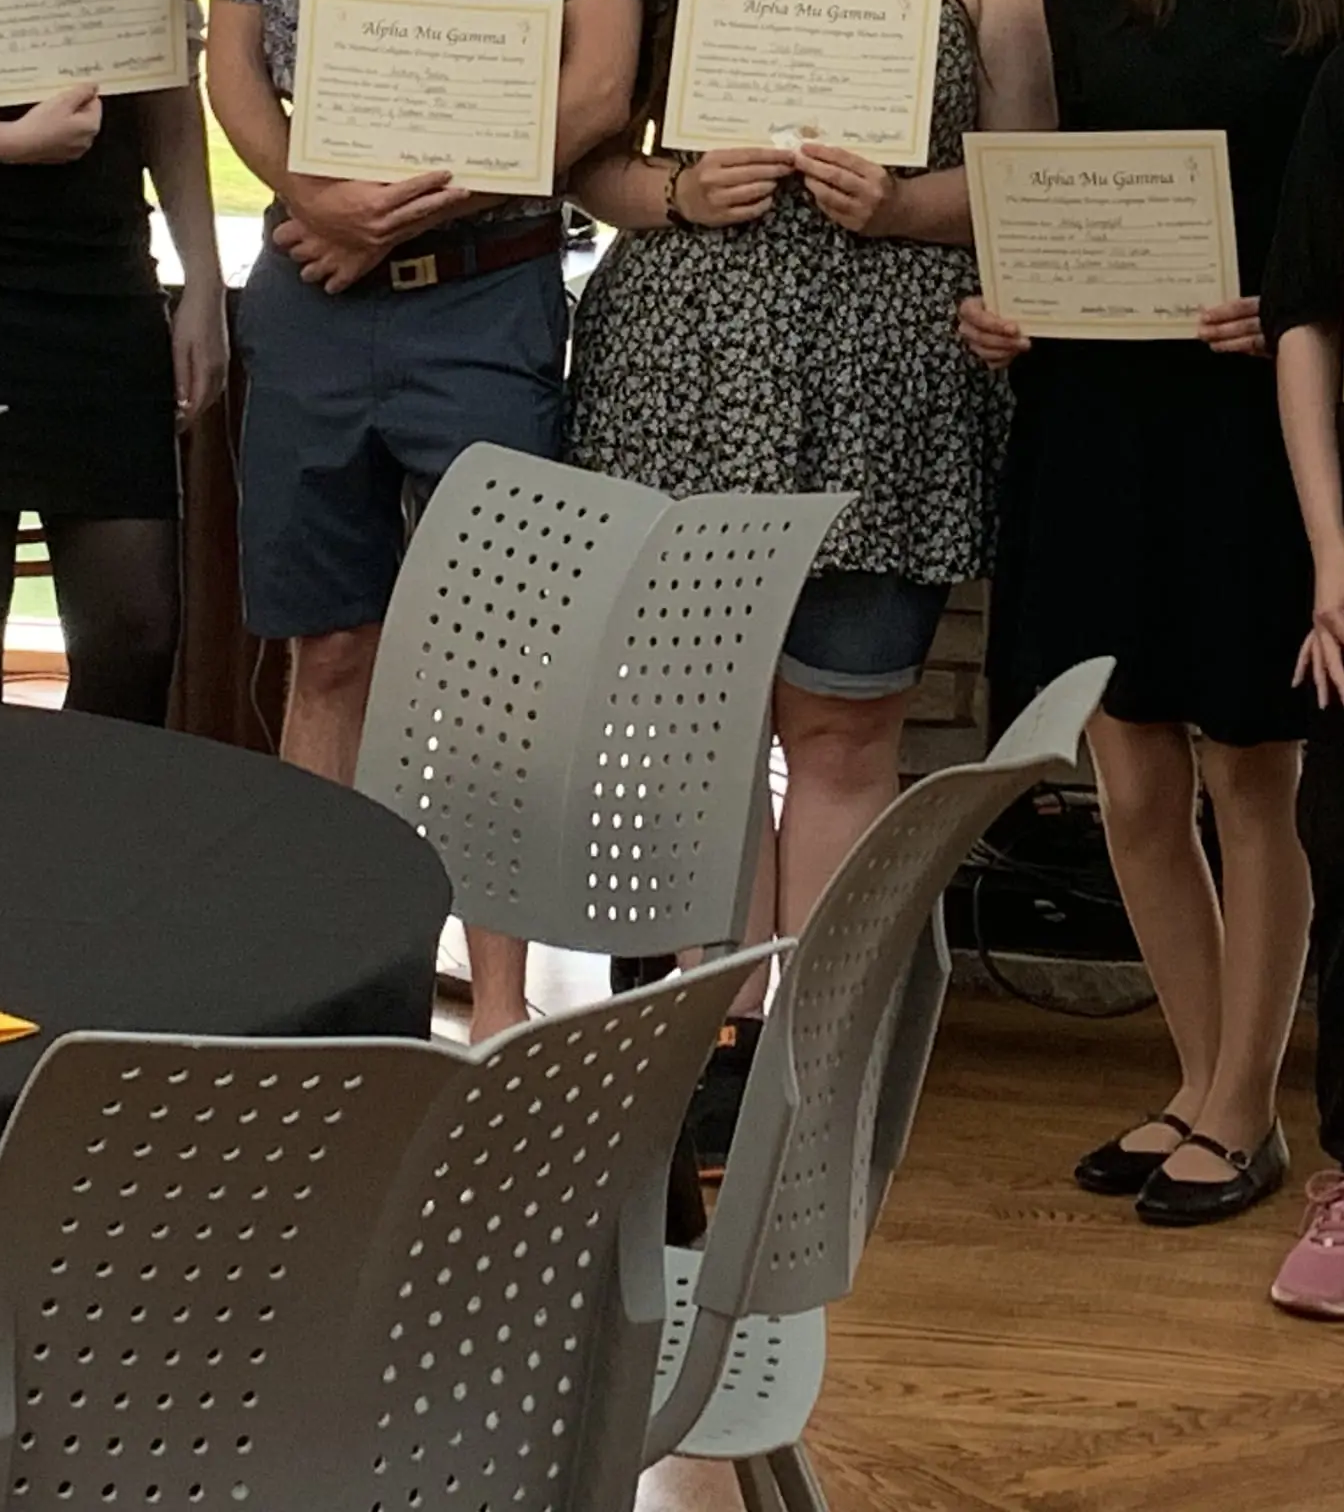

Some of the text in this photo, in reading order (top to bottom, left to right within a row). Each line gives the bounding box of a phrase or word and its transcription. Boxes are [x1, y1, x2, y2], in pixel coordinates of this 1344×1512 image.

[794, 4, 822, 17] Mu
[827, 5, 887, 23] Gamma
[362, 20, 506, 45] Alpha Mu Gamma
[1029, 169, 1174, 193] Alpha Mu Gamma
